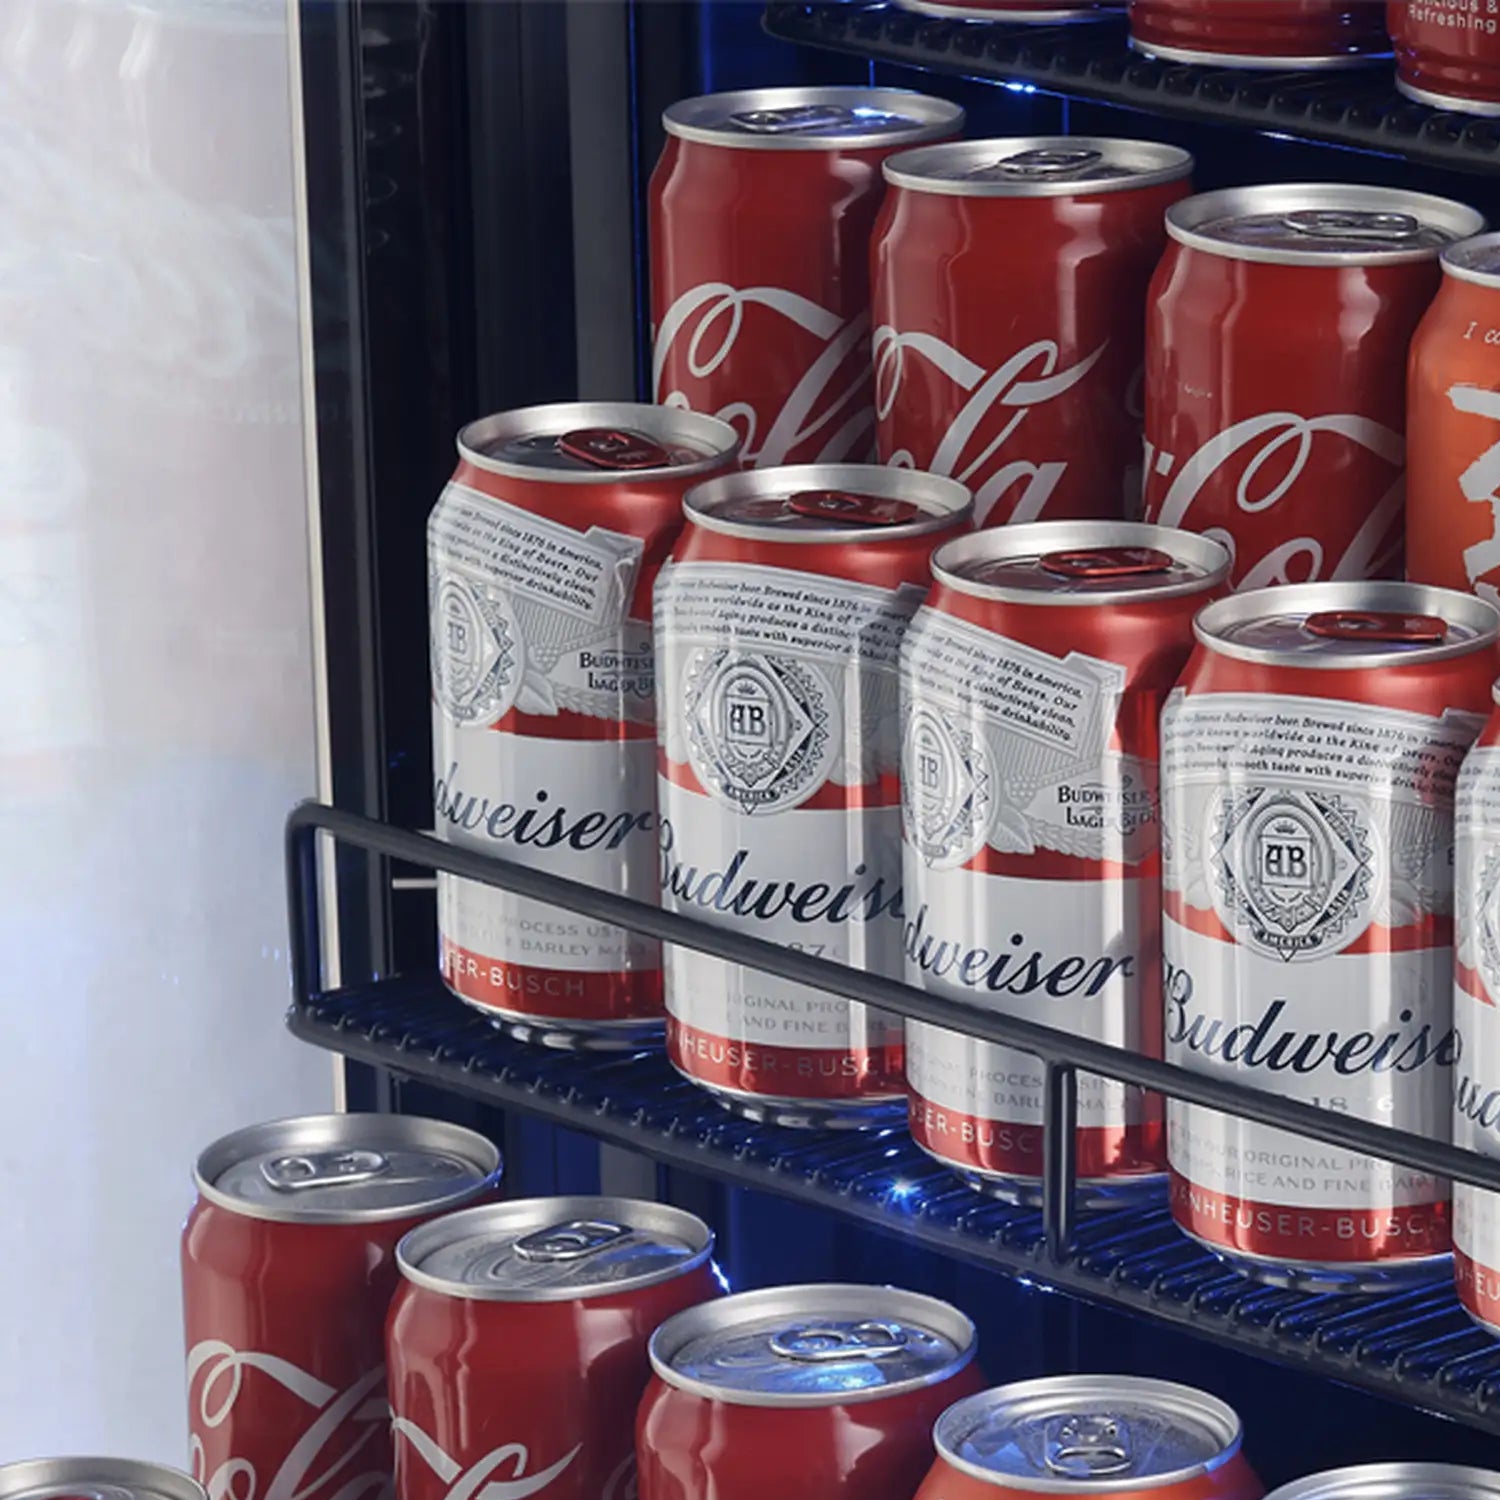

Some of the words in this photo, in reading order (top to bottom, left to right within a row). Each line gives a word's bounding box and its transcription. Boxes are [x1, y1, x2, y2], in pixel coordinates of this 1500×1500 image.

[1408, 3, 1497, 34] Refreshing
[1462, 321, 1479, 341] I
[1054, 696, 1078, 710] Our
[729, 703, 769, 736] AB
[1286, 748, 1342, 763] produces
[435, 762, 656, 850] dweiser
[659, 818, 905, 923] Budweis
[1265, 843, 1308, 879] AB
[904, 903, 1134, 998] dweiser
[784, 1017, 828, 1033] FINE
[1244, 1150, 1345, 1171] ORIGINAL
[1272, 1175, 1316, 1192] AND
[1324, 1179, 1370, 1193] FINE
